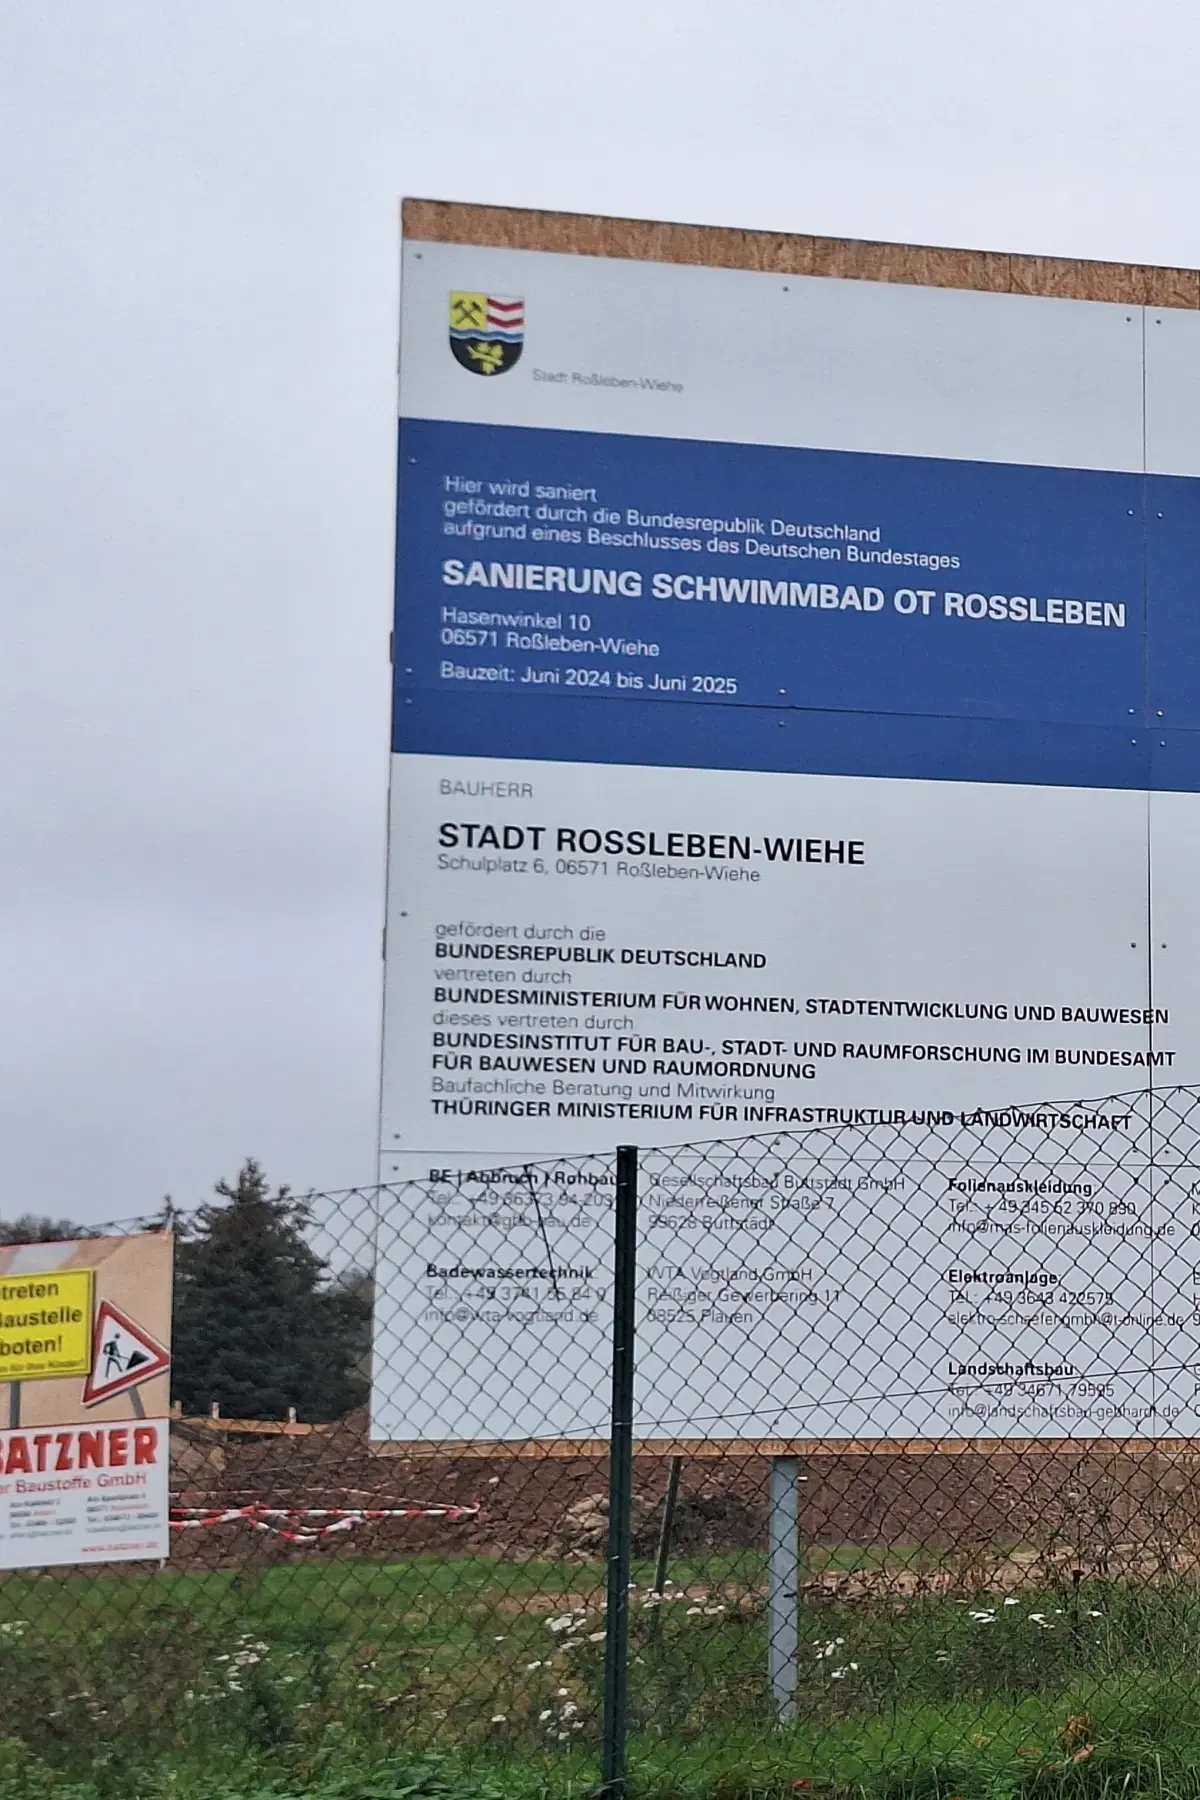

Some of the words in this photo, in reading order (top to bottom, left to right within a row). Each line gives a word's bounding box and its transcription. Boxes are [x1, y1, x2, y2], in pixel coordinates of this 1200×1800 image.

[444, 475, 484, 495] Hier
[487, 480, 530, 497] wird
[534, 484, 598, 502] saniert
[443, 499, 531, 523] gefördert
[535, 504, 588, 524] durch
[592, 507, 622, 526] die
[626, 509, 766, 538] Bundesrepublik
[770, 518, 881, 543] Deutschland
[443, 520, 527, 541] aufgrund
[531, 525, 582, 543] eines
[587, 528, 702, 551] Beschlusses
[707, 534, 740, 554] des
[745, 539, 841, 561] Deutschen
[846, 544, 961, 571] Bundestages
[442, 559, 642, 598] SANIERUNG
[651, 572, 885, 612] SCHWIMMBAD
[893, 588, 937, 616] OT
[944, 591, 1126, 628] ROSSLEBEN
[441, 606, 562, 630] Hasenwinkel
[569, 613, 591, 632] 10
[440, 629, 498, 648] 06571
[506, 631, 660, 657] Roßleben-Wiehe
[439, 660, 516, 683] Bauzeit:
[519, 665, 560, 685] Juni
[564, 668, 614, 689] 2024
[615, 670, 644, 690] bis
[647, 672, 687, 692] Juni
[690, 675, 738, 695] 2025
[439, 778, 534, 799] BAUHERR
[437, 822, 547, 851] STADT
[556, 827, 865, 865] ROSSLEBEN-WIEHE
[437, 852, 529, 875] Schulplatz
[533, 858, 549, 876] 6,
[555, 857, 608, 877] 06571
[616, 860, 761, 883] Roßleben-Wiehe
[435, 920, 519, 942] gefördert
[523, 923, 574, 940] durch
[579, 925, 607, 942] die
[435, 941, 616, 964] BUNDESREPUBLIK
[620, 948, 767, 969] DEUTSCHLAND
[434, 969, 516, 983] vertreten
[522, 967, 572, 984] durch
[433, 986, 656, 1009] BUNDESMINISTERIUM
[662, 992, 701, 1011] FÜR
[704, 994, 800, 1016] WOHNEN,
[805, 998, 1008, 1020] STADTENTWICKLUNG
[1014, 1004, 1056, 1022] UND
[1061, 1006, 1169, 1026] BAUWESEN
[433, 1010, 492, 1028] dieses
[498, 1015, 579, 1029] vertreten
[585, 1014, 634, 1031] durch
[431, 1050, 473, 1071] FÜR
[479, 1054, 596, 1074] BAUWESEN
[602, 1058, 647, 1075] UND
[653, 1059, 816, 1080] RAUMORDNUNG
[432, 1031, 613, 1052] BUNDESINSTITUT
[617, 1034, 657, 1054] FÜR
[662, 1037, 717, 1057] BAU-,
[721, 1039, 789, 1057] STADT-
[793, 1041, 837, 1058] UND
[842, 1042, 1021, 1064] RAUMFORSCHUNG
[1027, 1047, 1049, 1064] IM
[1055, 1047, 1177, 1069] BUNDESAMT
[431, 1076, 546, 1095] Baufachliche
[553, 1079, 632, 1101] Beratung
[638, 1082, 671, 1098] und
[676, 1083, 775, 1106] Mitwirkung
[430, 1096, 551, 1118] THÜRINGER
[556, 1101, 693, 1121] MINISTERIUM
[699, 1102, 738, 1123] FÜR
[743, 1105, 905, 1127] INFRASTRUKTUR
[911, 1109, 954, 1127] UND
[961, 1110, 1133, 1131] LANDWIRTSCHAFT
[0, 1305, 83, 1328] austelle
[0, 1426, 157, 1475] ATZNER
[96, 1472, 147, 1488] GmbH
